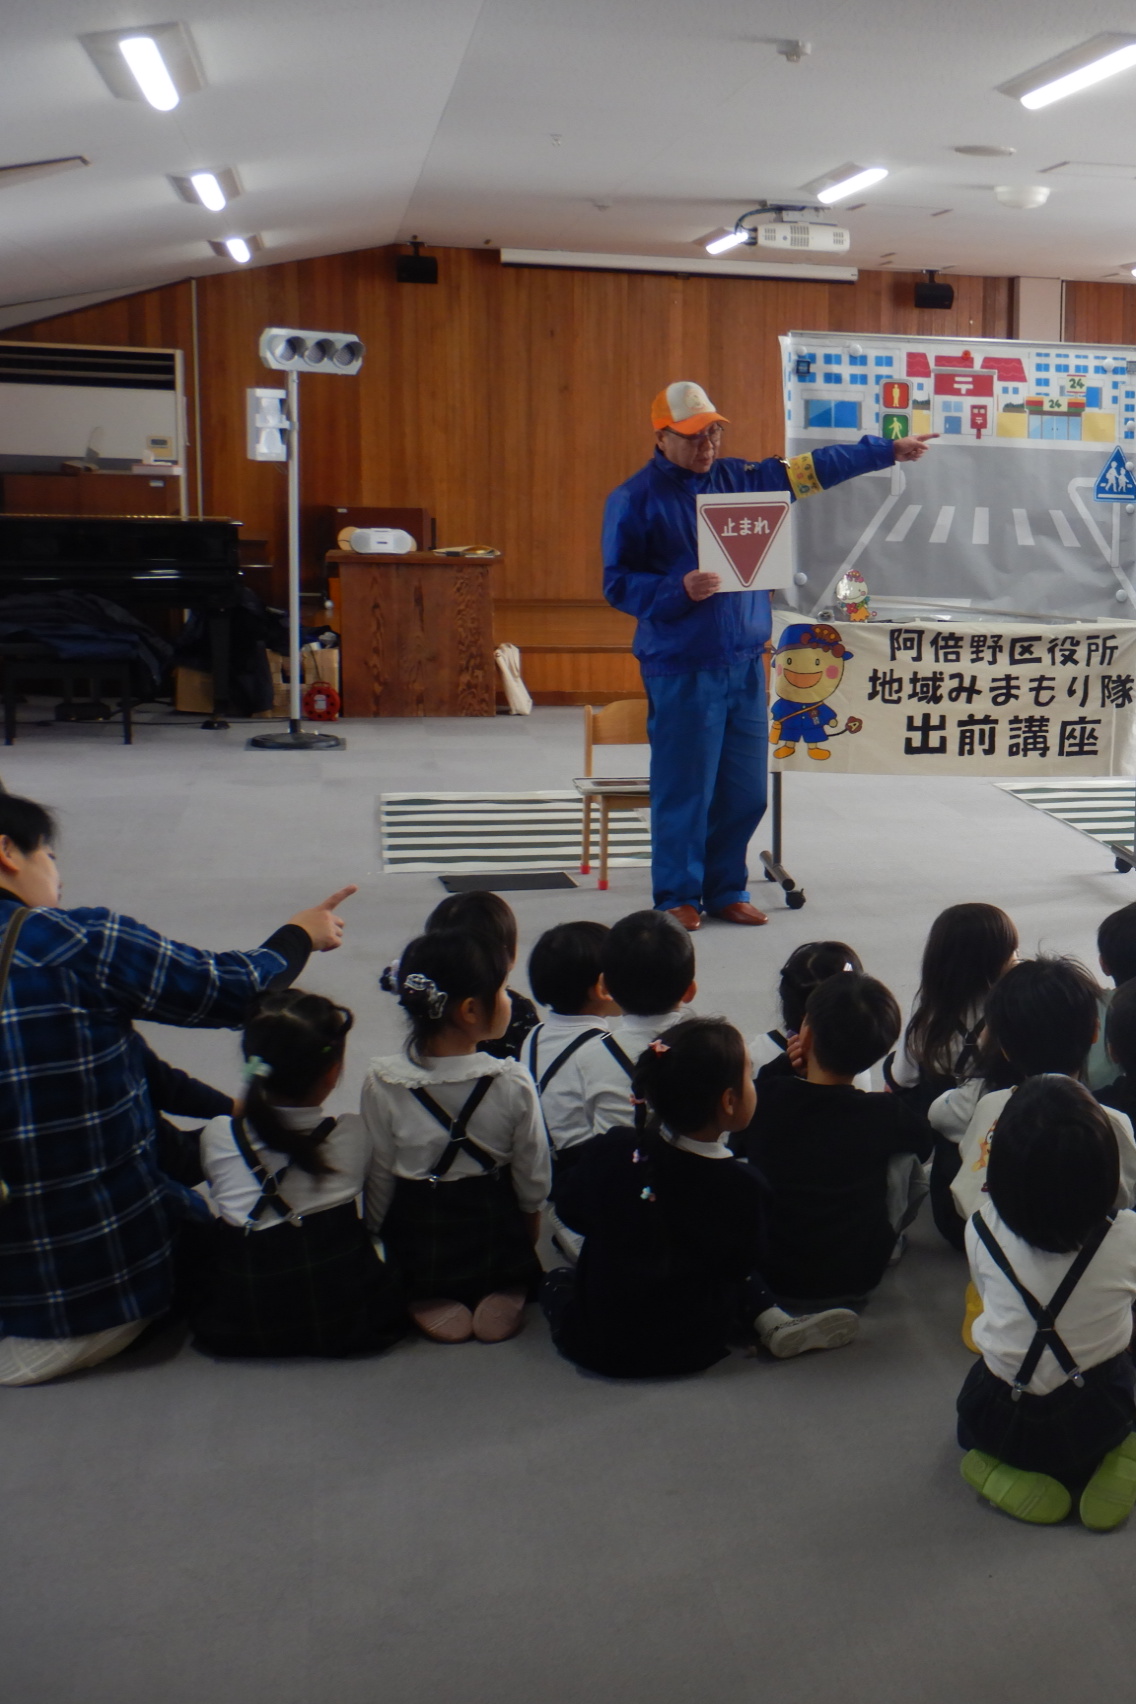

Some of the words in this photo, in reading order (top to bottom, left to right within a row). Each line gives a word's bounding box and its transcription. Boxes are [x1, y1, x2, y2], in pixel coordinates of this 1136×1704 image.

[1068, 378, 1085, 389] 24
[1048, 399, 1062, 409] 24
[721, 517, 770, 536] 止まれ
[889, 628, 1119, 667] 阿倍野区役所
[867, 668, 1135, 708] 地域みまもり隊
[904, 713, 1102, 757] 出前講座
